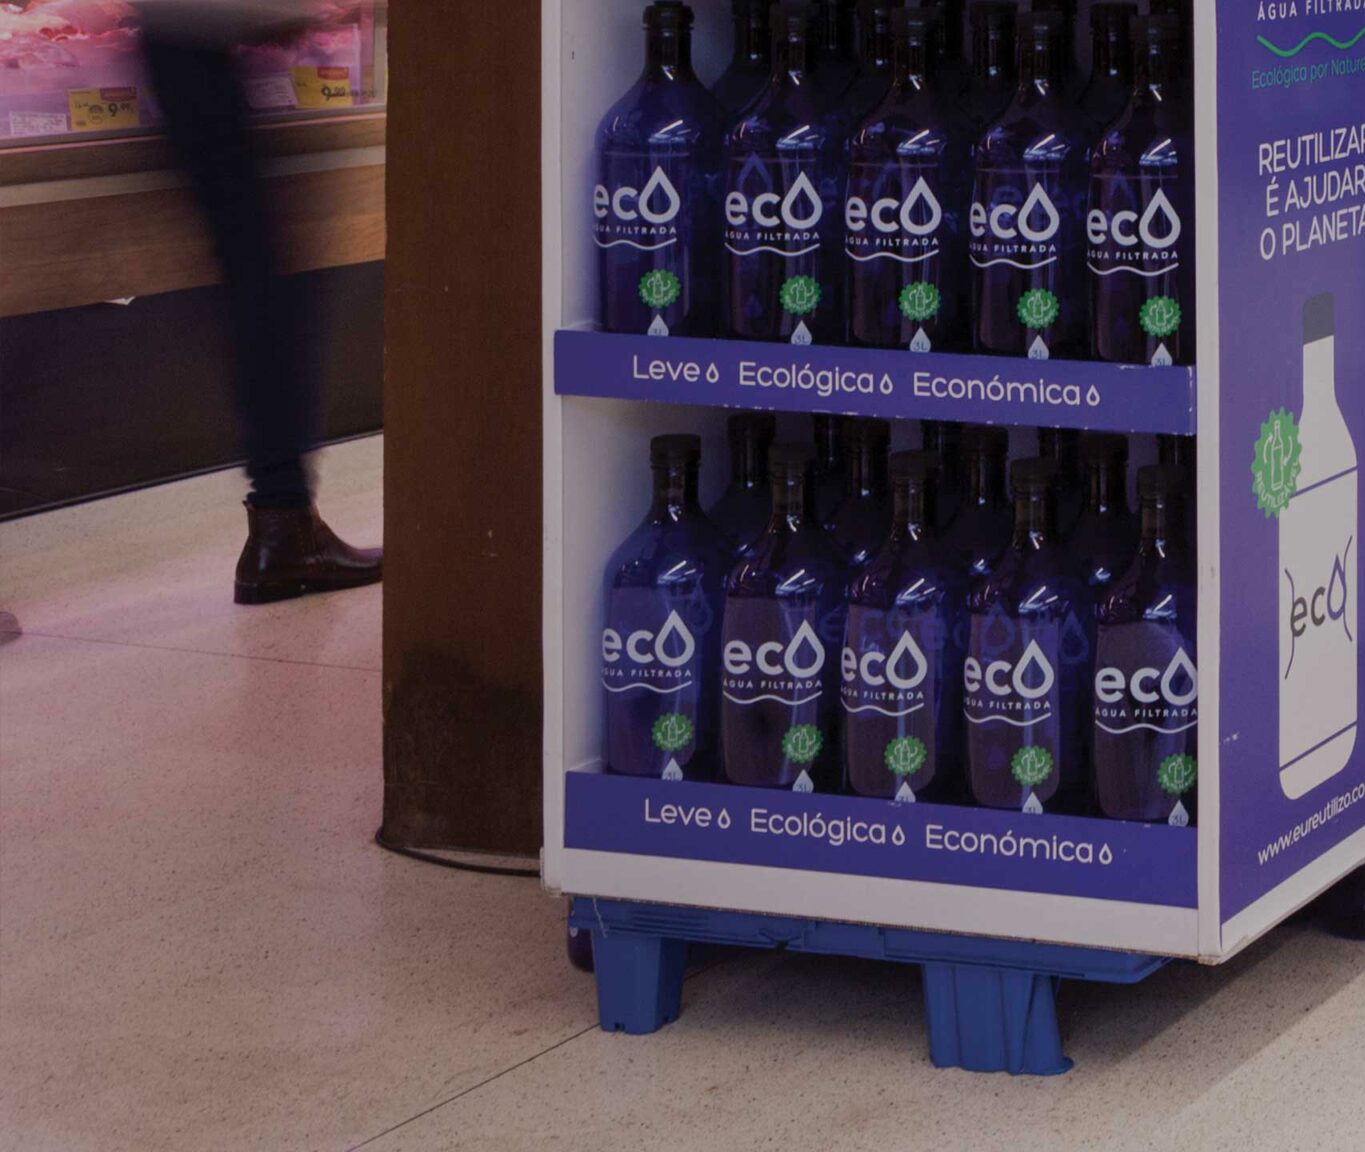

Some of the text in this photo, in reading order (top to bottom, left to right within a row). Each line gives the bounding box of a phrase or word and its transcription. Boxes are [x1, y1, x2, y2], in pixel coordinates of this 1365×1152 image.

[1256, 0, 1298, 21] ÁGUA
[1251, 63, 1308, 90] Ecológica
[1309, 61, 1329, 80] por
[1266, 176, 1279, 217] É
[755, 232, 820, 242] FILTRADA
[1260, 227, 1276, 261] O
[633, 354, 1081, 405] Leve Ecológica Económica
[760, 681, 823, 690] FILTRADA
[1133, 708, 1198, 718] FILTRADA
[644, 798, 1090, 865] Leve Ecológica Económica
